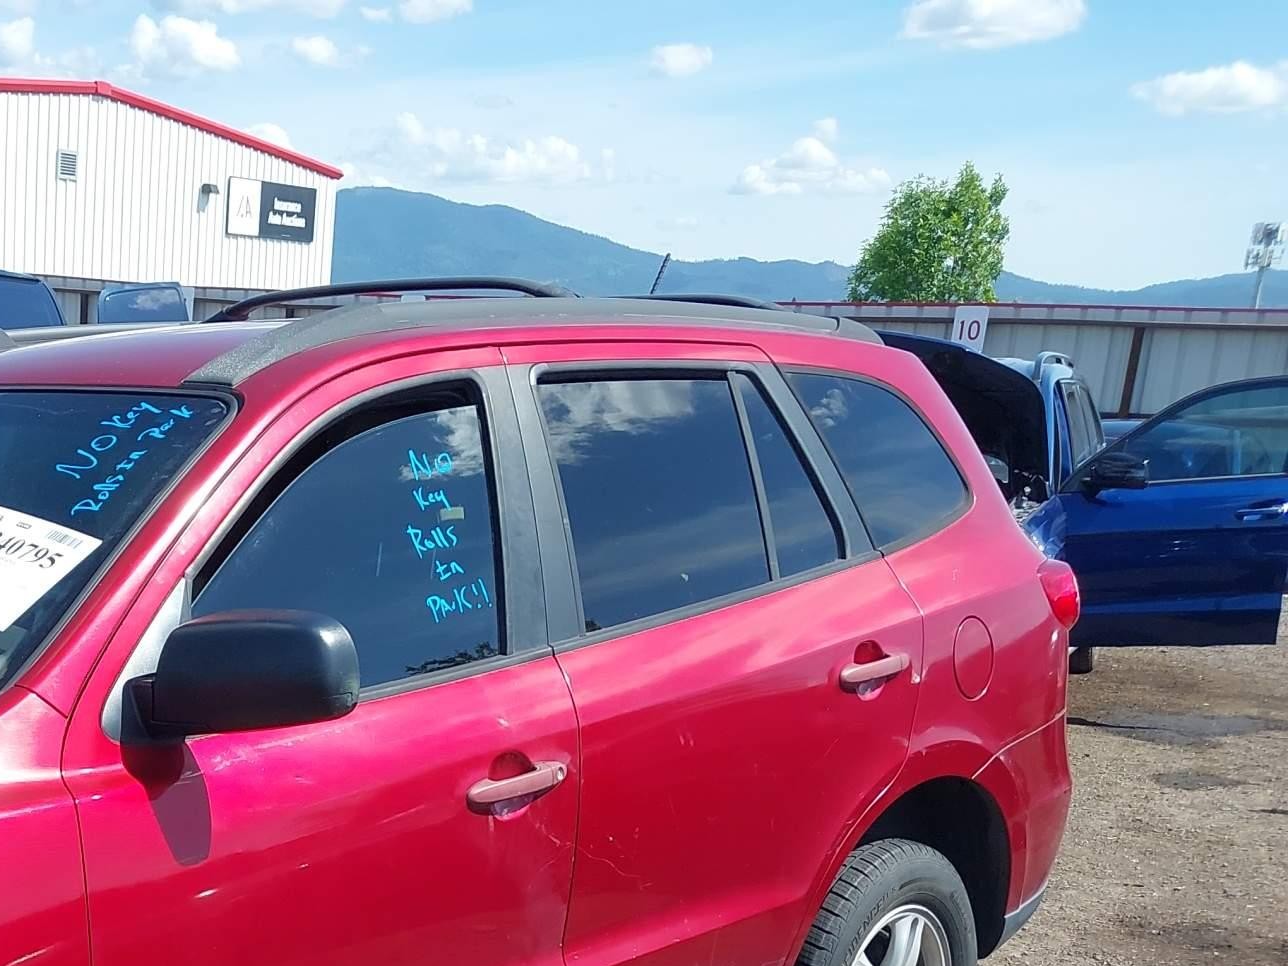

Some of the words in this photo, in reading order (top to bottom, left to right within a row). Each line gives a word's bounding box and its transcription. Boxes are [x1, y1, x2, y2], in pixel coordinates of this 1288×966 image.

[959, 320, 981, 341] 10
[100, 401, 163, 429] Key
[413, 486, 452, 511] Key
[406, 525, 458, 559] Rolls
